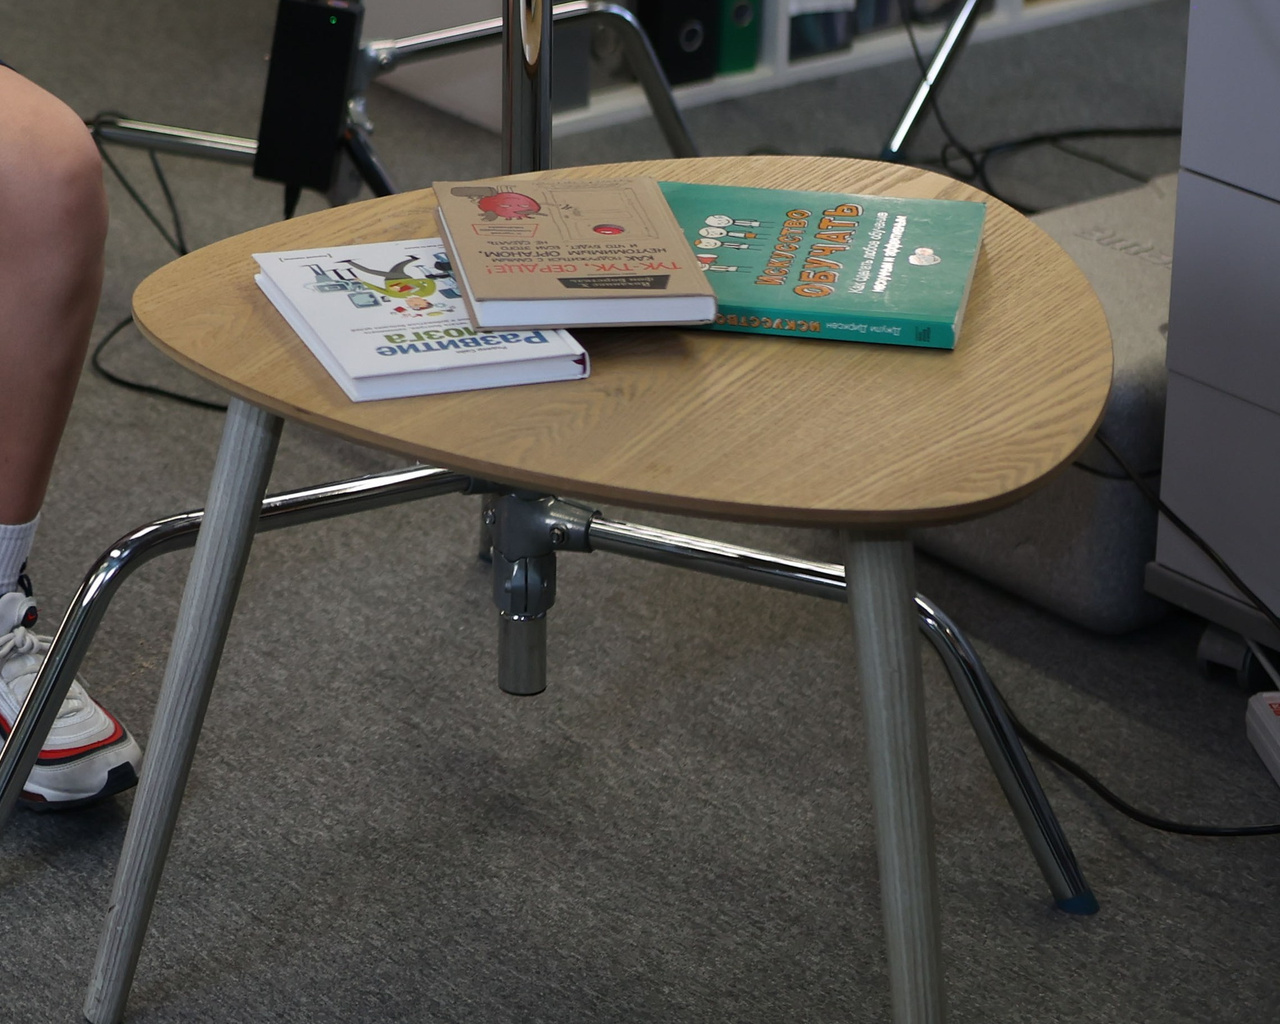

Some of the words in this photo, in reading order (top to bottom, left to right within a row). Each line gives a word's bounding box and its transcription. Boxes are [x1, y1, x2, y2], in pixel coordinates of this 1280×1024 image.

[754, 209, 812, 285] ИСКУССТВО
[792, 203, 865, 297] ОБУЧАТЬ
[484, 263, 578, 274] СЕРДЦЕ!
[585, 262, 682, 272] ТУК-ТУК,
[848, 282, 866, 294] Как
[375, 331, 549, 358] Развитие
